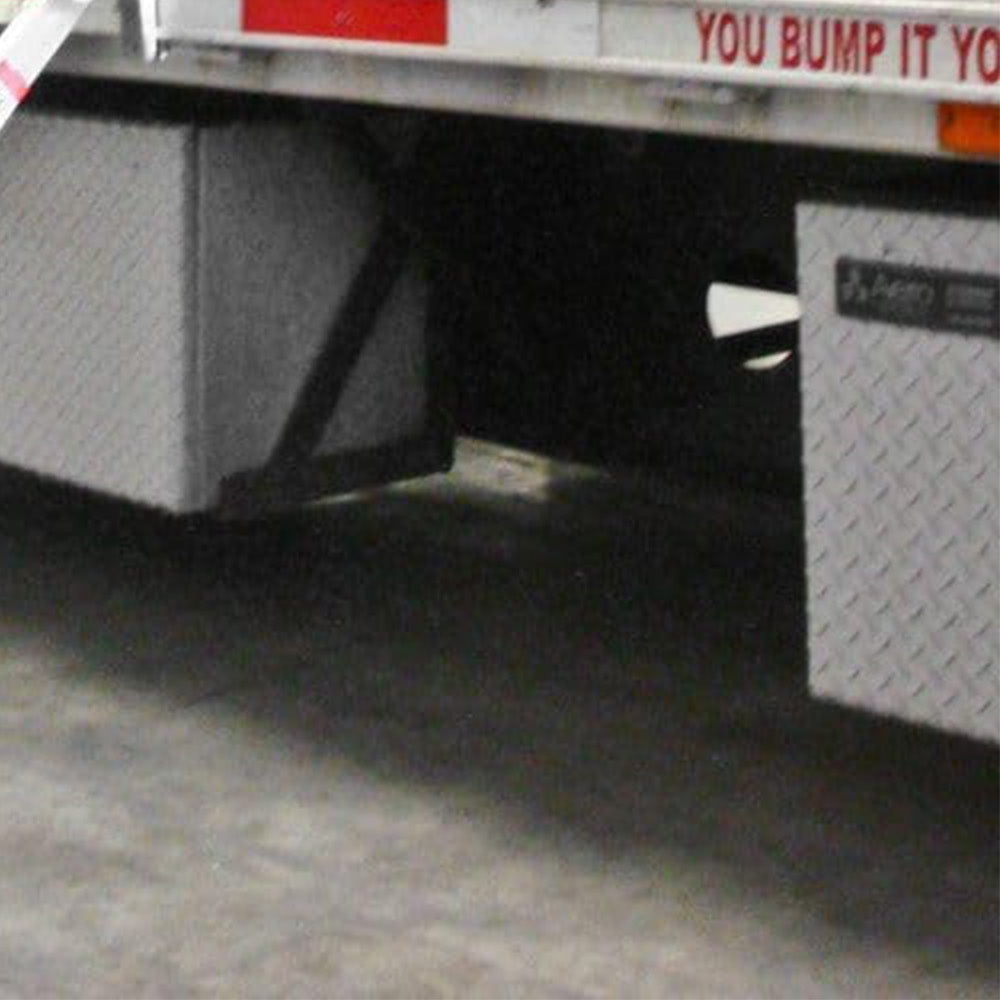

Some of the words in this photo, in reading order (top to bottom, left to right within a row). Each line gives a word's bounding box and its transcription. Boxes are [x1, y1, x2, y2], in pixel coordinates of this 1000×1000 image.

[695, 9, 766, 66] YOU
[780, 16, 886, 75] BUMP
[901, 23, 937, 80] IT
